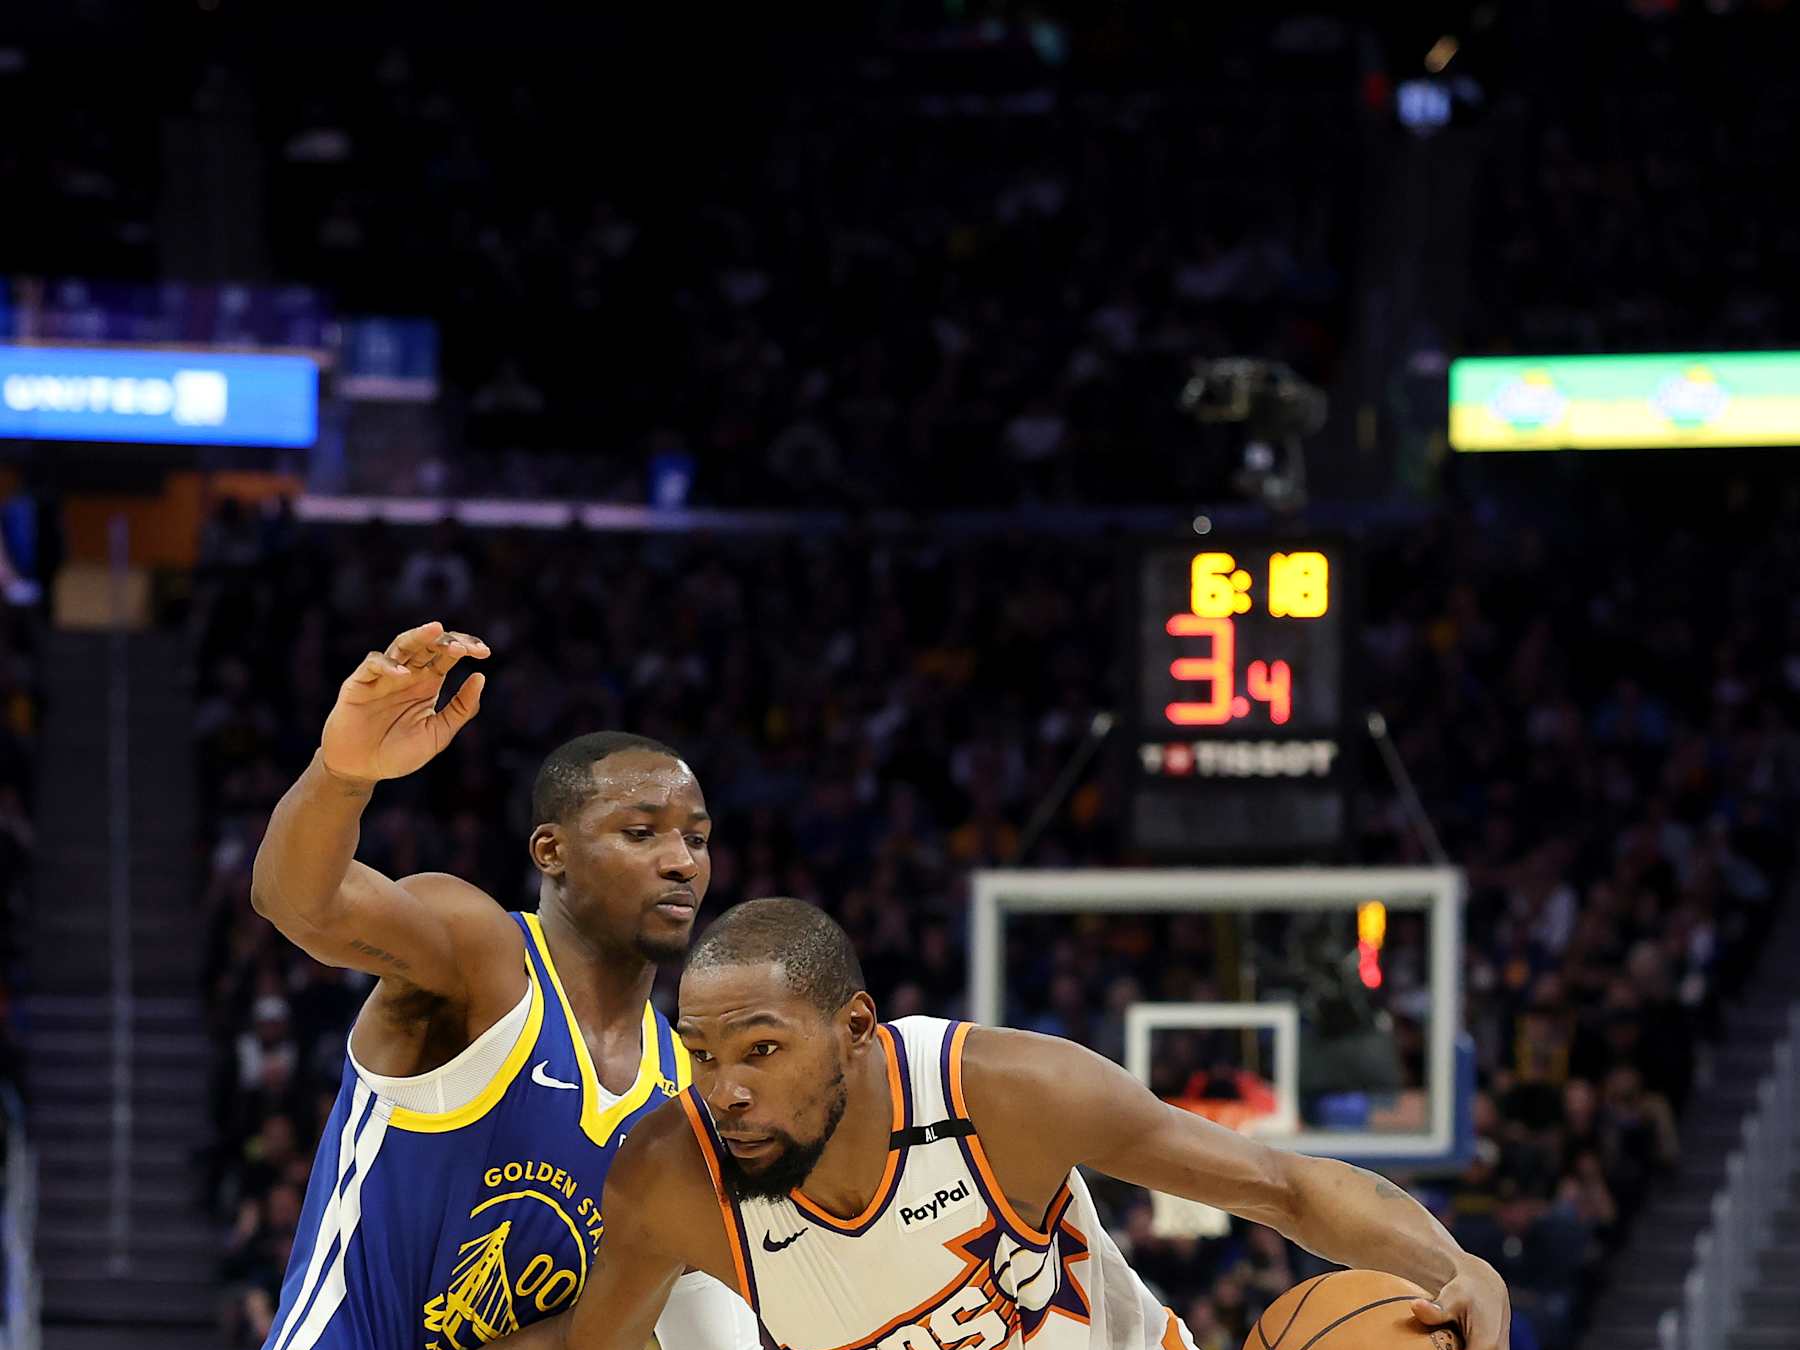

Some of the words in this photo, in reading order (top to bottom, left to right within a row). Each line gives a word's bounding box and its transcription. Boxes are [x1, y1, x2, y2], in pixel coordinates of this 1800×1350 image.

[1165, 613, 1291, 725] 3.4
[1195, 741, 1338, 777] TISSOT
[924, 1126, 938, 1143] AL
[484, 1161, 578, 1200] GOLDEN
[577, 1198, 605, 1255] STA
[899, 1179, 970, 1226] PayPal
[516, 1253, 577, 1313] 00
